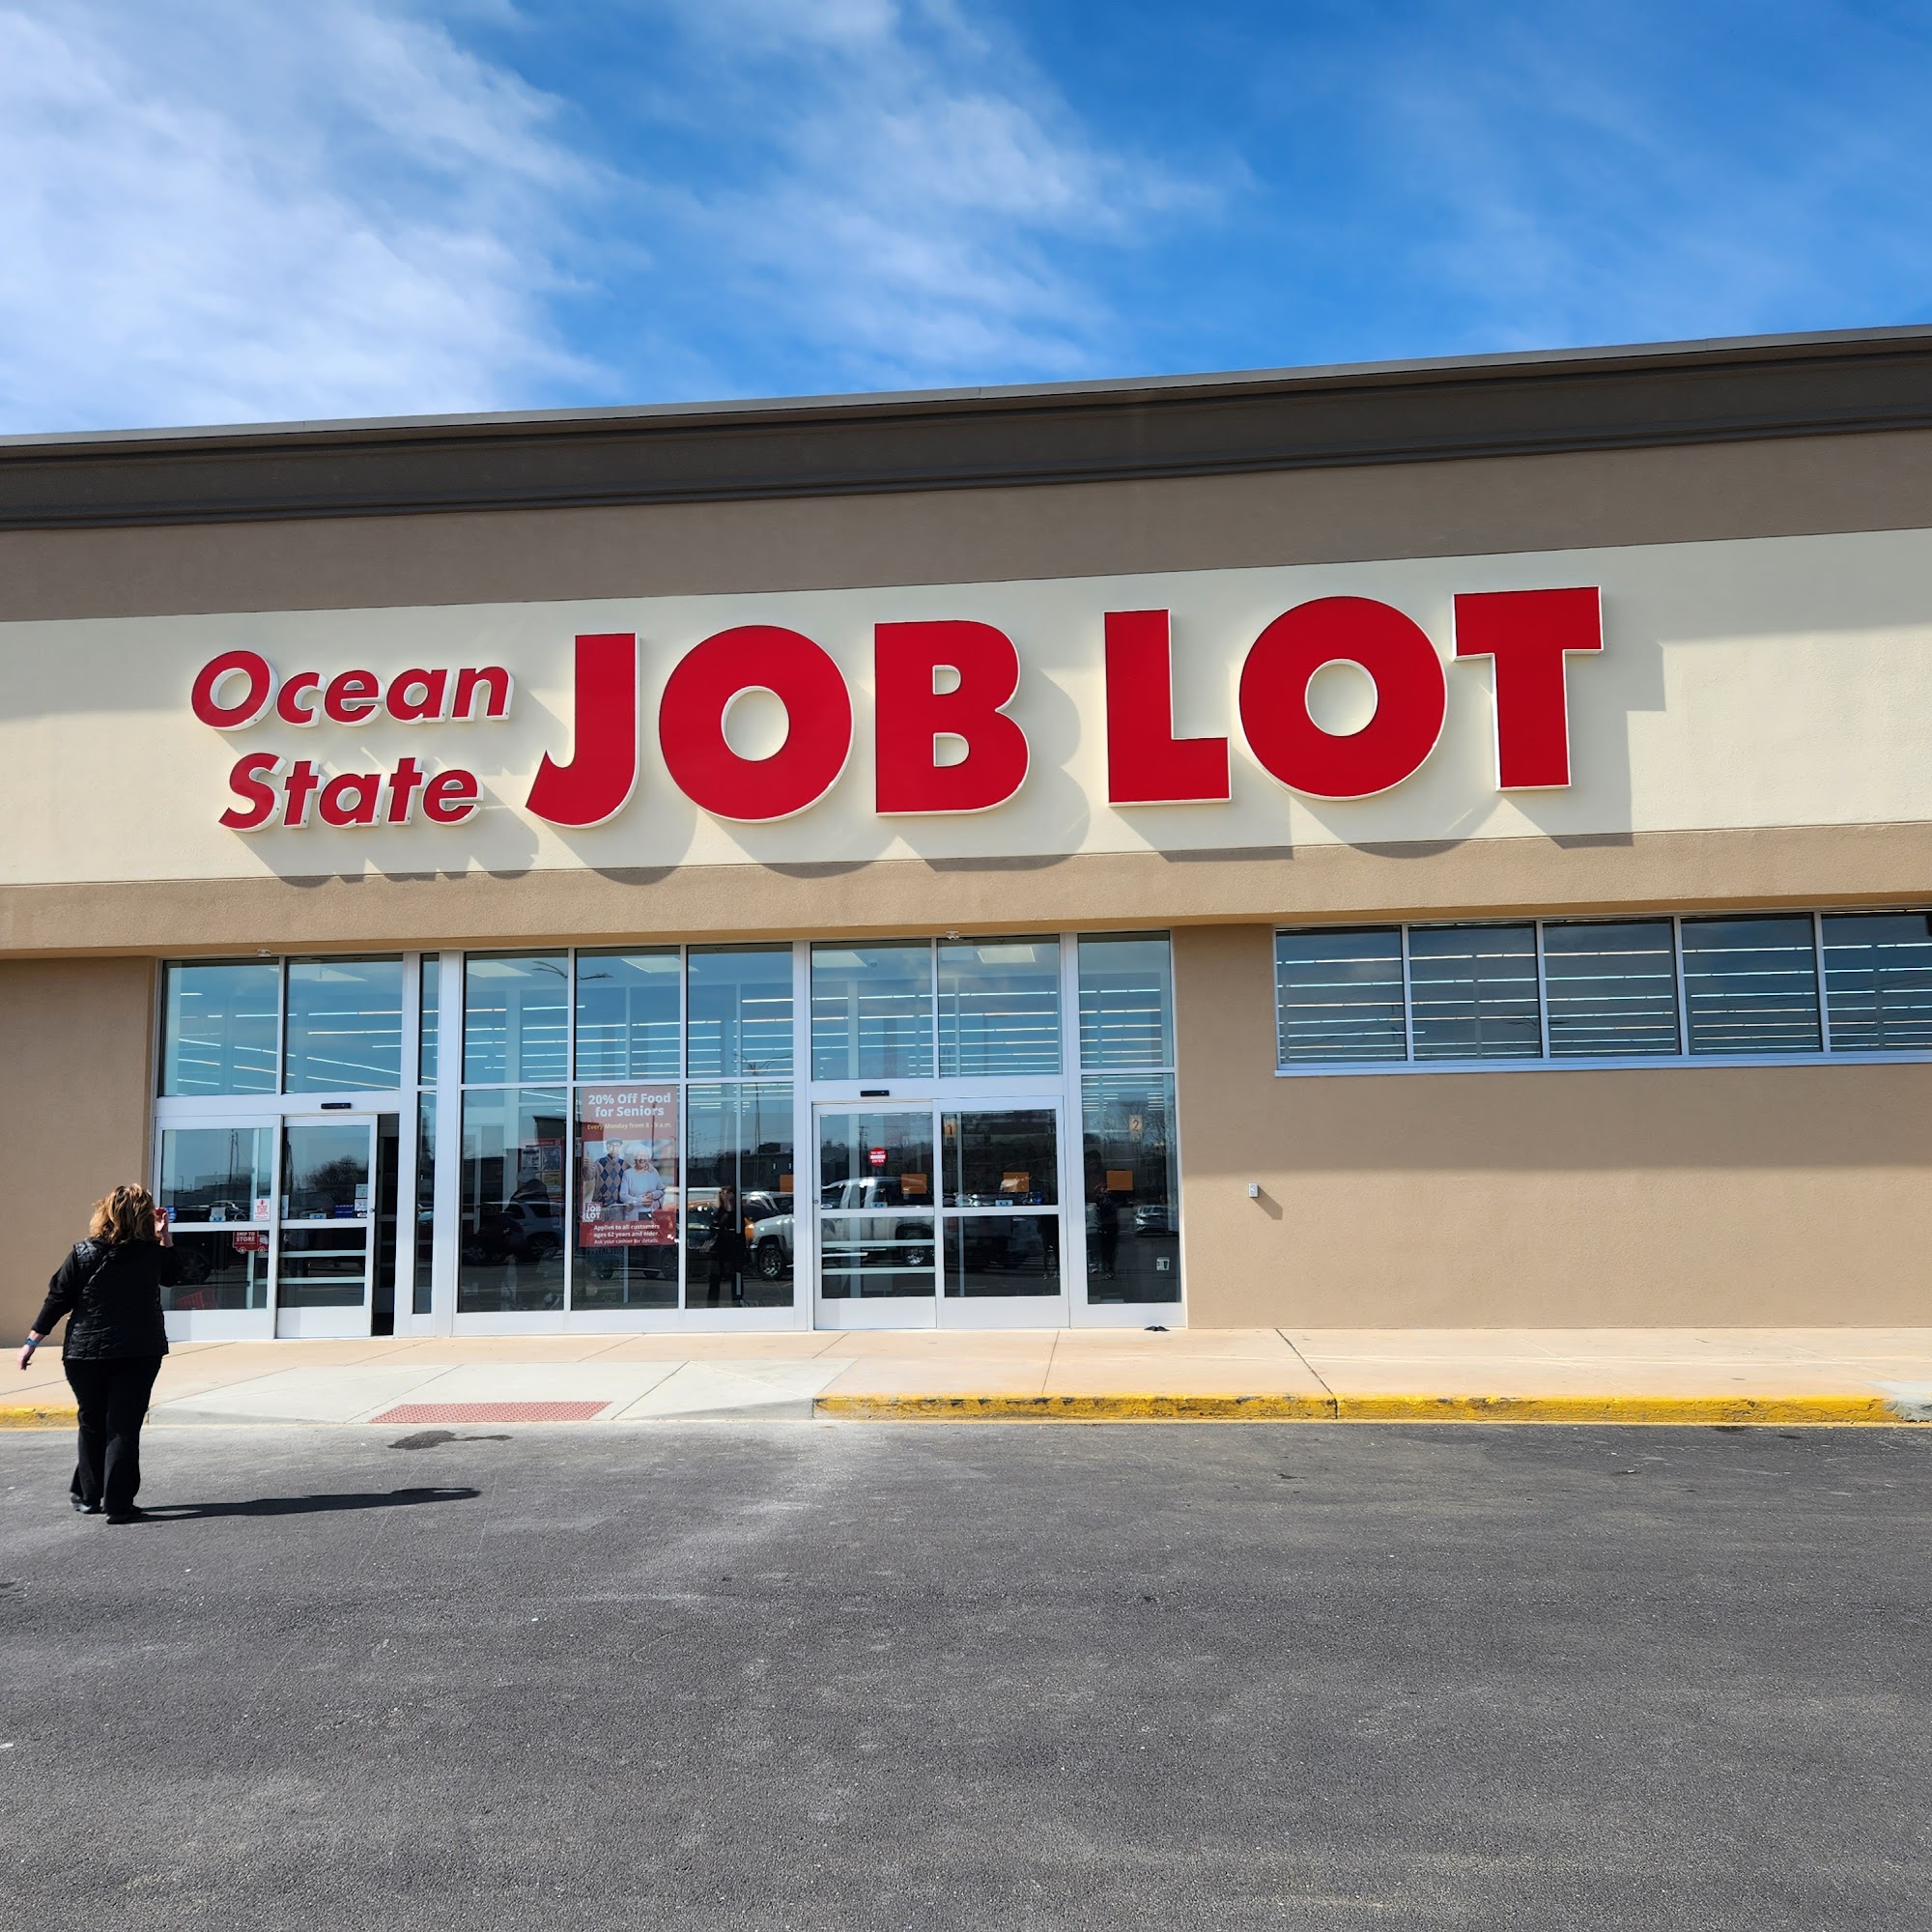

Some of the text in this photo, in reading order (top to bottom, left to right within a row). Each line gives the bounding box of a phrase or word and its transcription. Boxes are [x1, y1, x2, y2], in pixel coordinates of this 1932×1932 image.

[191, 649, 513, 728] Ocean
[526, 585, 1604, 827] JOB LOT
[219, 752, 482, 831] State
[587, 1093, 671, 1105] 20% Off Food
[595, 1105, 665, 1118] for Seniors
[1132, 1119, 1140, 1131] 2
